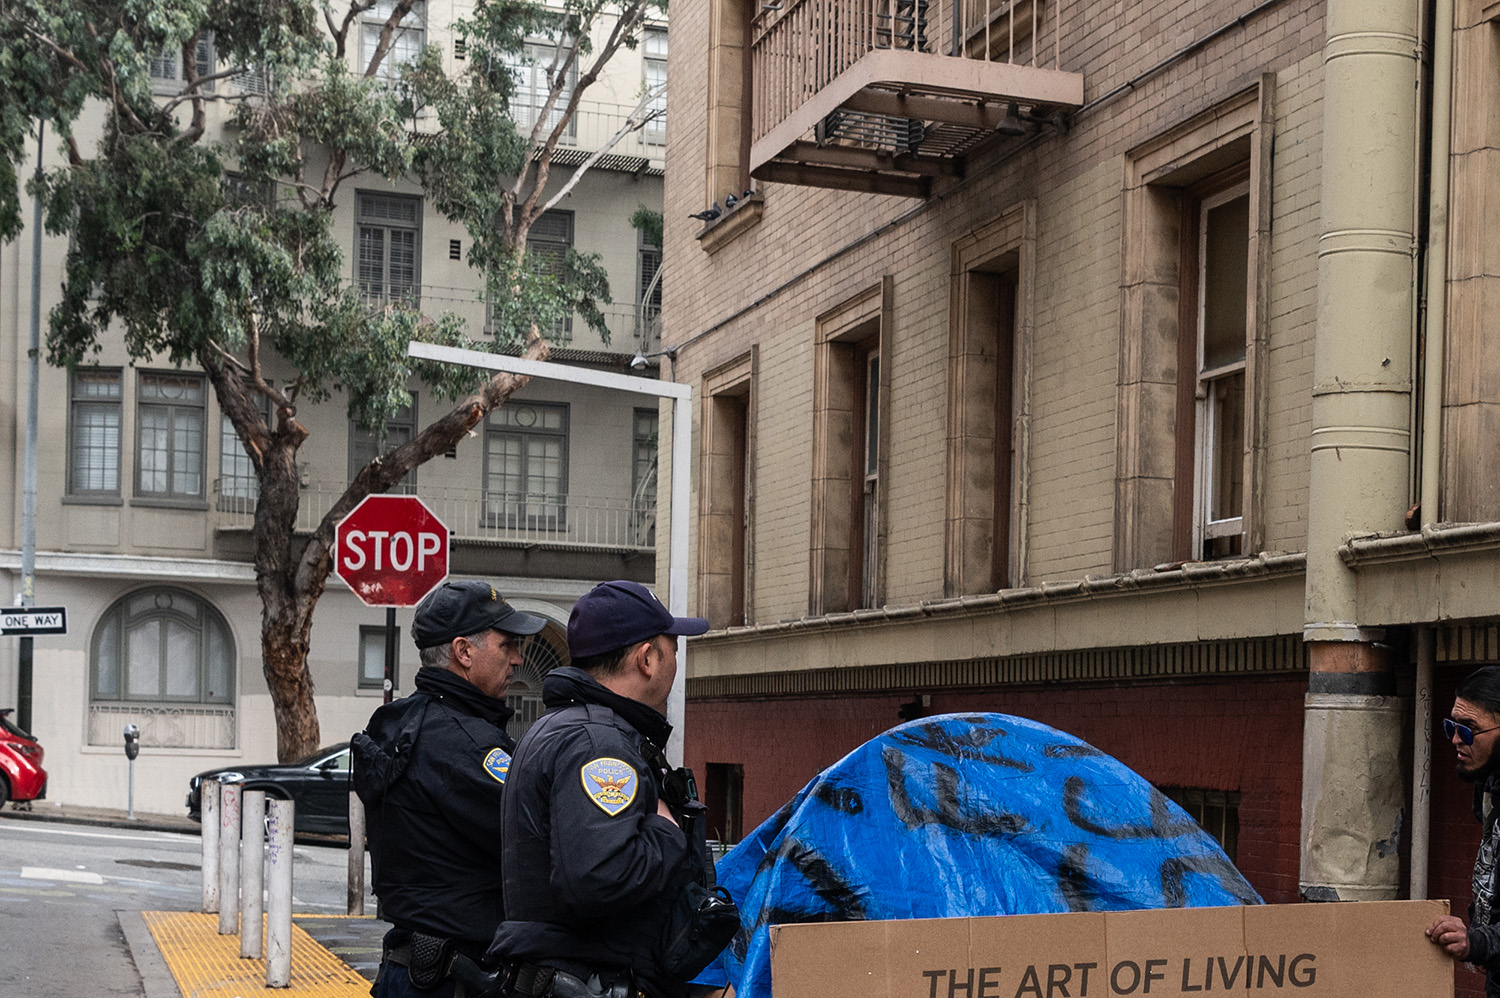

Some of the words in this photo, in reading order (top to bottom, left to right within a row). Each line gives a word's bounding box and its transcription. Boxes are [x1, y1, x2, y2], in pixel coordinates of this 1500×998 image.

[343, 529, 442, 572] STOP
[5, 616, 29, 627] ONE
[34, 614, 59, 626] WAY
[597, 768, 623, 776] POLICE
[1110, 958, 1168, 996] OF
[1180, 952, 1318, 993] LIVING
